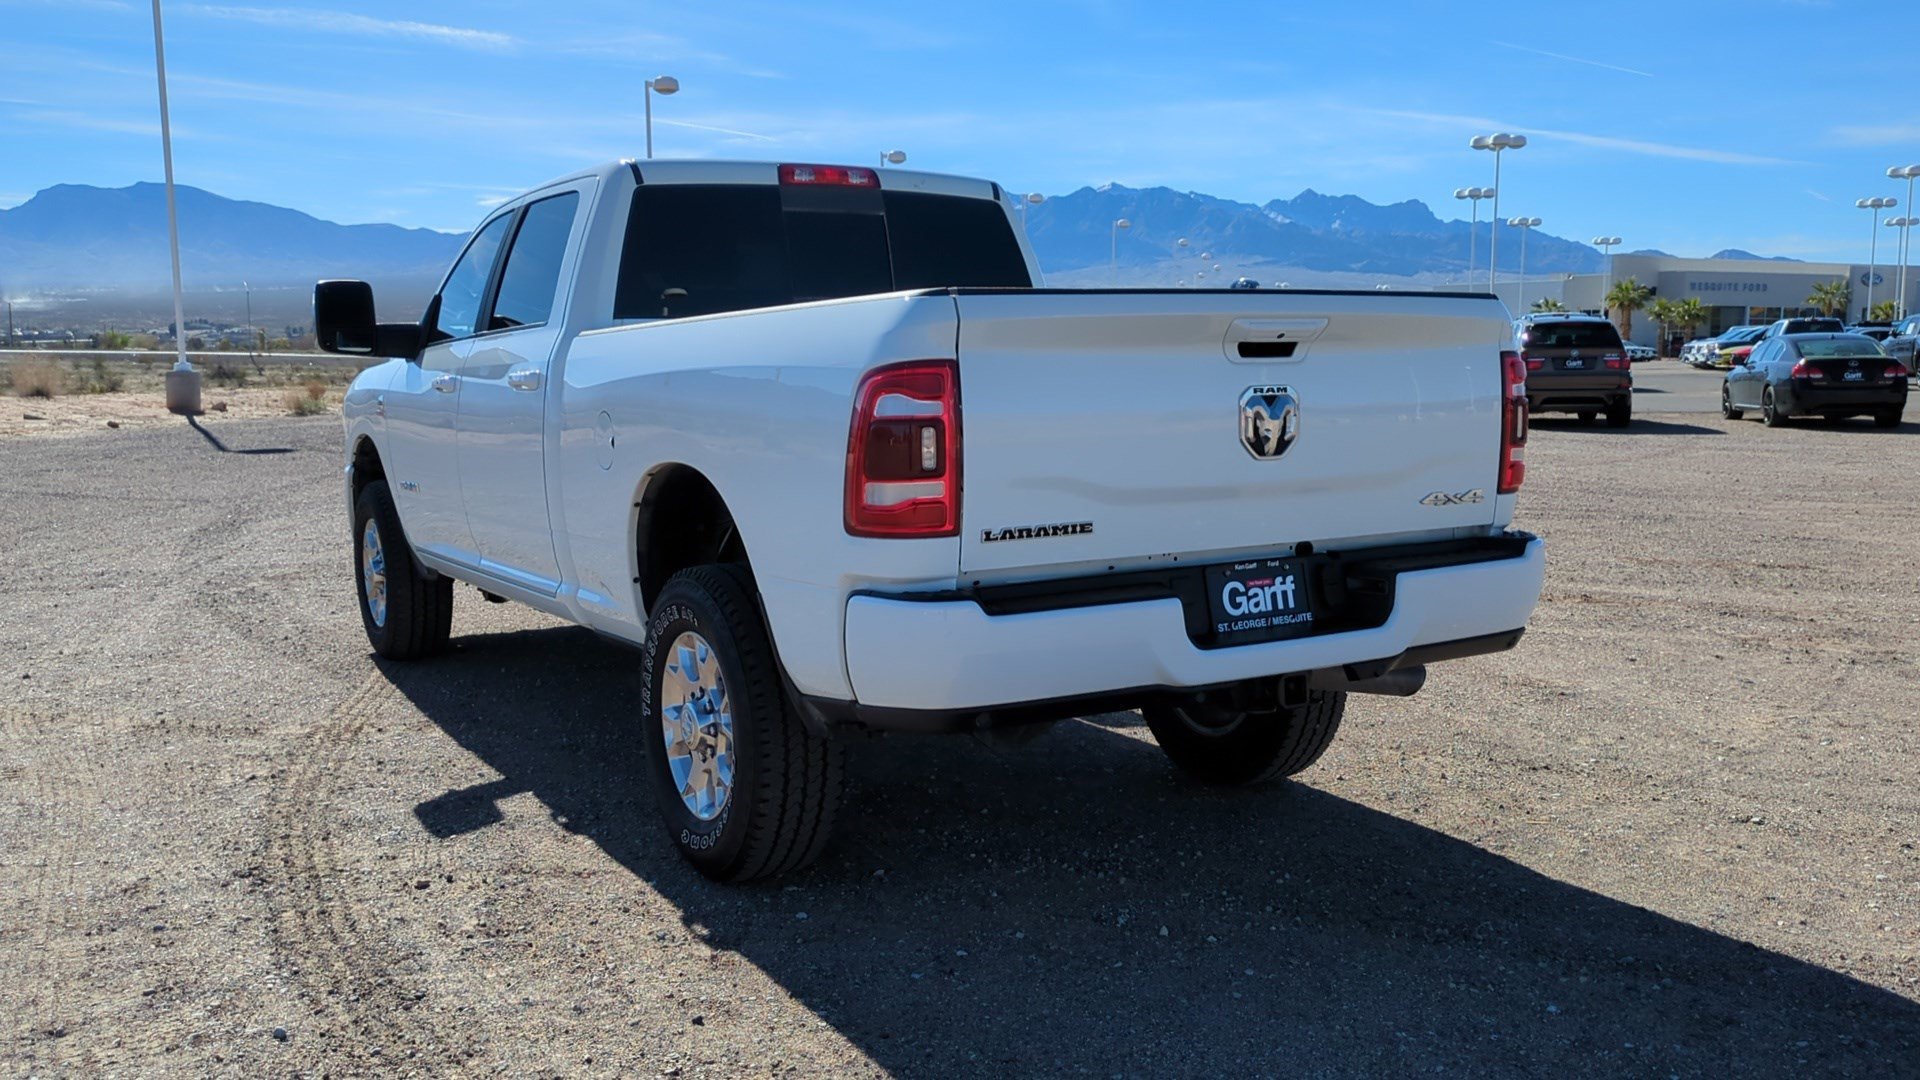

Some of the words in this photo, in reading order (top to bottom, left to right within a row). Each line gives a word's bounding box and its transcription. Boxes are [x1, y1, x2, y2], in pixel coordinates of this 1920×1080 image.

[1690, 282, 1738, 291] MESQUITE
[1743, 283, 1768, 292] FORD
[1253, 386, 1288, 394] RAM
[982, 521, 1093, 543] LARAMIE
[1222, 575, 1295, 616] Garff
[1218, 623, 1231, 633] ST.
[1232, 618, 1267, 630] GEORGE
[642, 605, 680, 716] TRANSFORCE
